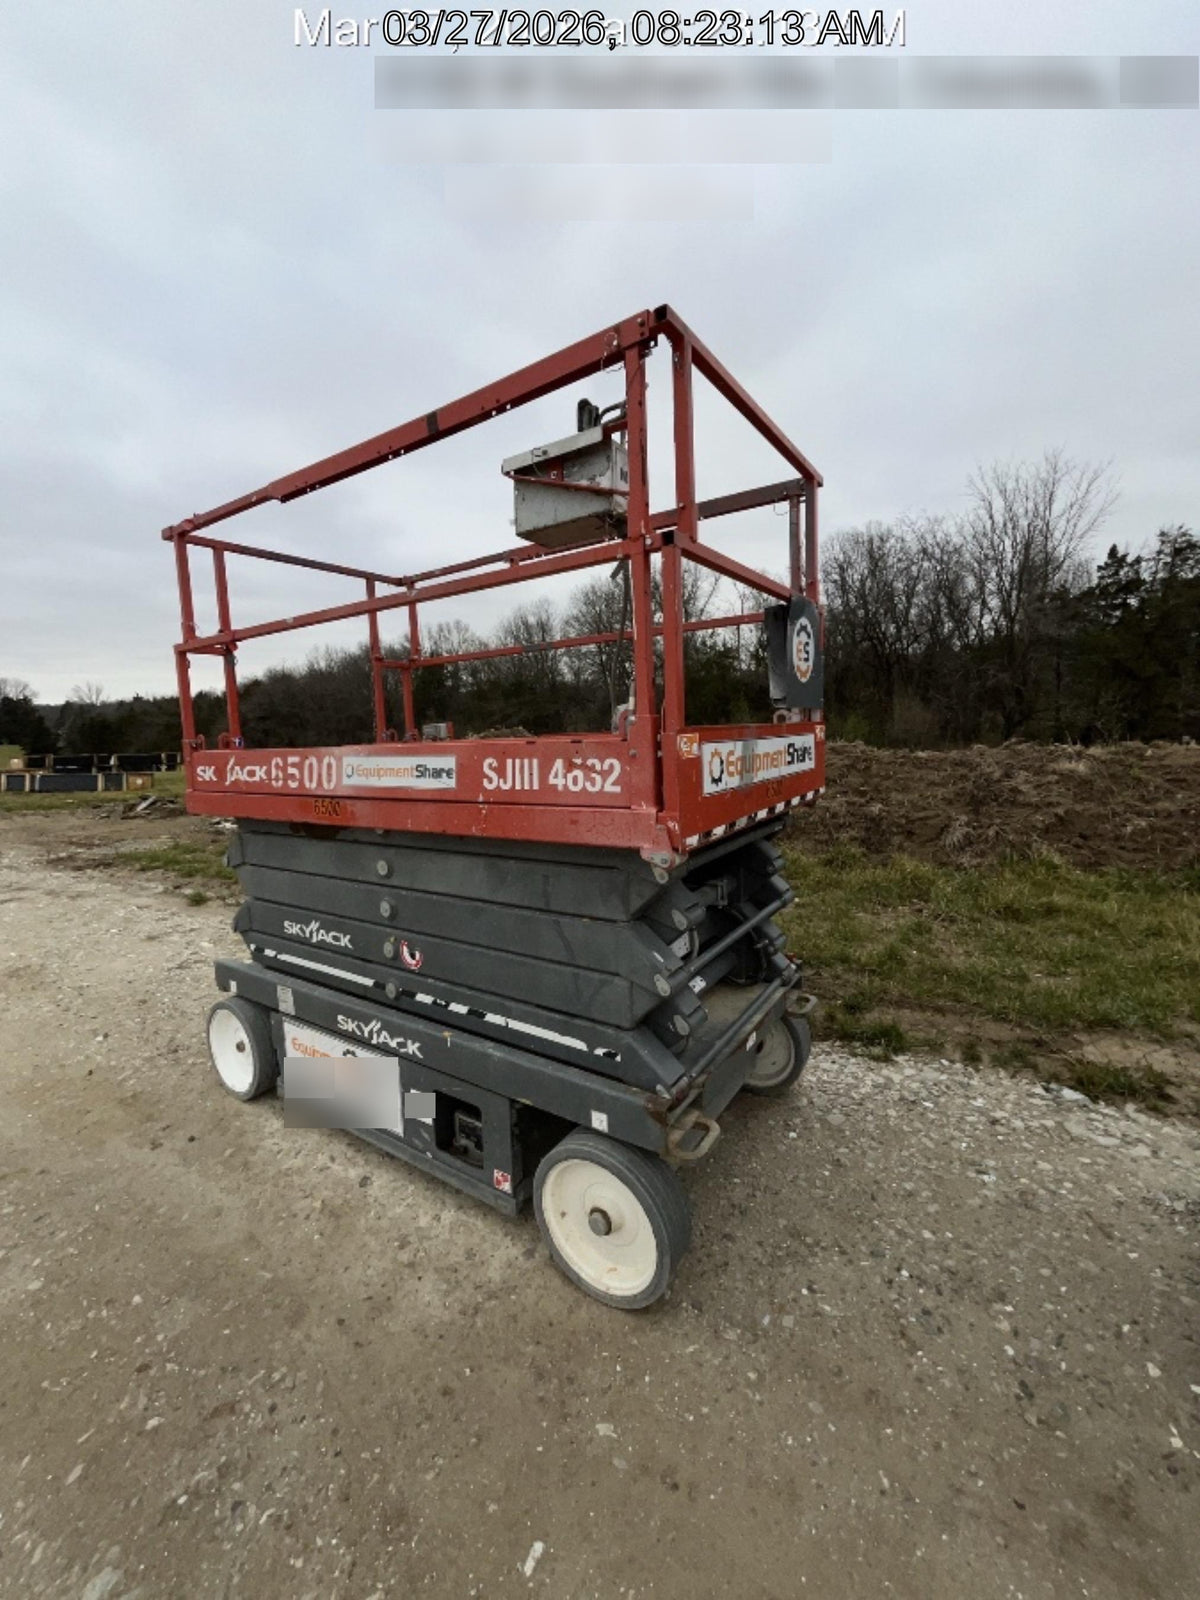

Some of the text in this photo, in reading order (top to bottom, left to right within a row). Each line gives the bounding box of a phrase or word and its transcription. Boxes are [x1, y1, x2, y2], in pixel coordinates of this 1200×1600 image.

[271, 755, 337, 790] 6500
[355, 763, 455, 781] EquipmentShare
[283, 919, 354, 950] SKYJACK
[336, 1013, 424, 1059] SKYJACK
